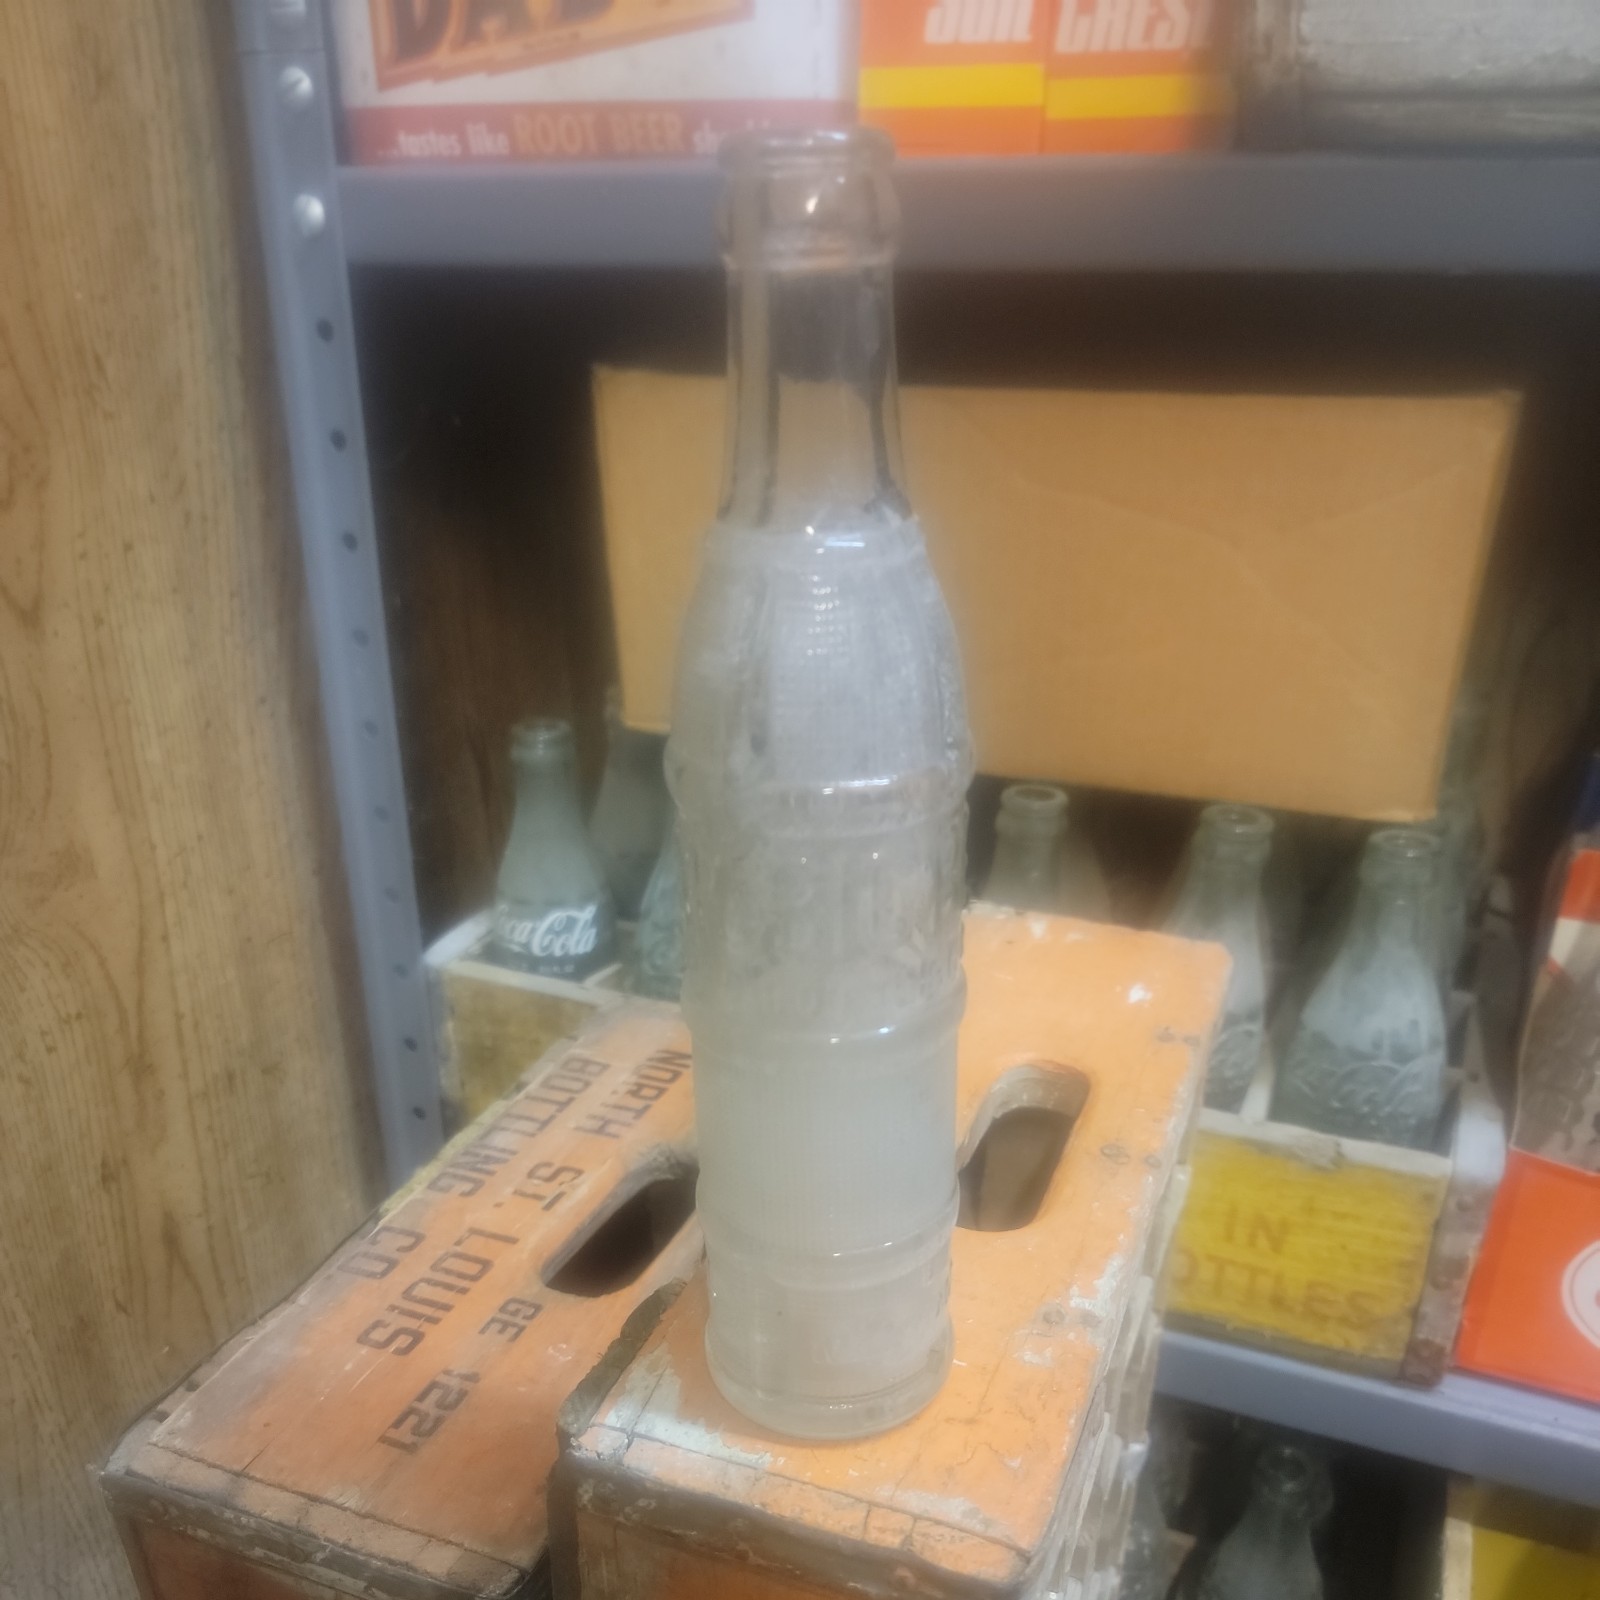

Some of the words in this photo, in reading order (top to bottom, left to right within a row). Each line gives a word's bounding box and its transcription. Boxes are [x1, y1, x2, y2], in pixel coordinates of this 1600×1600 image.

[465, 121, 509, 157] like
[512, 111, 598, 156] ROOT
[610, 111, 686, 154] BEER
[531, 904, 598, 957] Cola
[427, 1056, 611, 1198] BOTTLING
[573, 1049, 692, 1139] NORTH
[337, 1225, 427, 1280] CO
[1222, 1198, 1291, 1255] IN
[356, 1226, 520, 1358] LOUIS
[478, 1296, 544, 1344] GE
[1170, 1247, 1387, 1331] OTTLES
[377, 1367, 481, 1455] 1221
